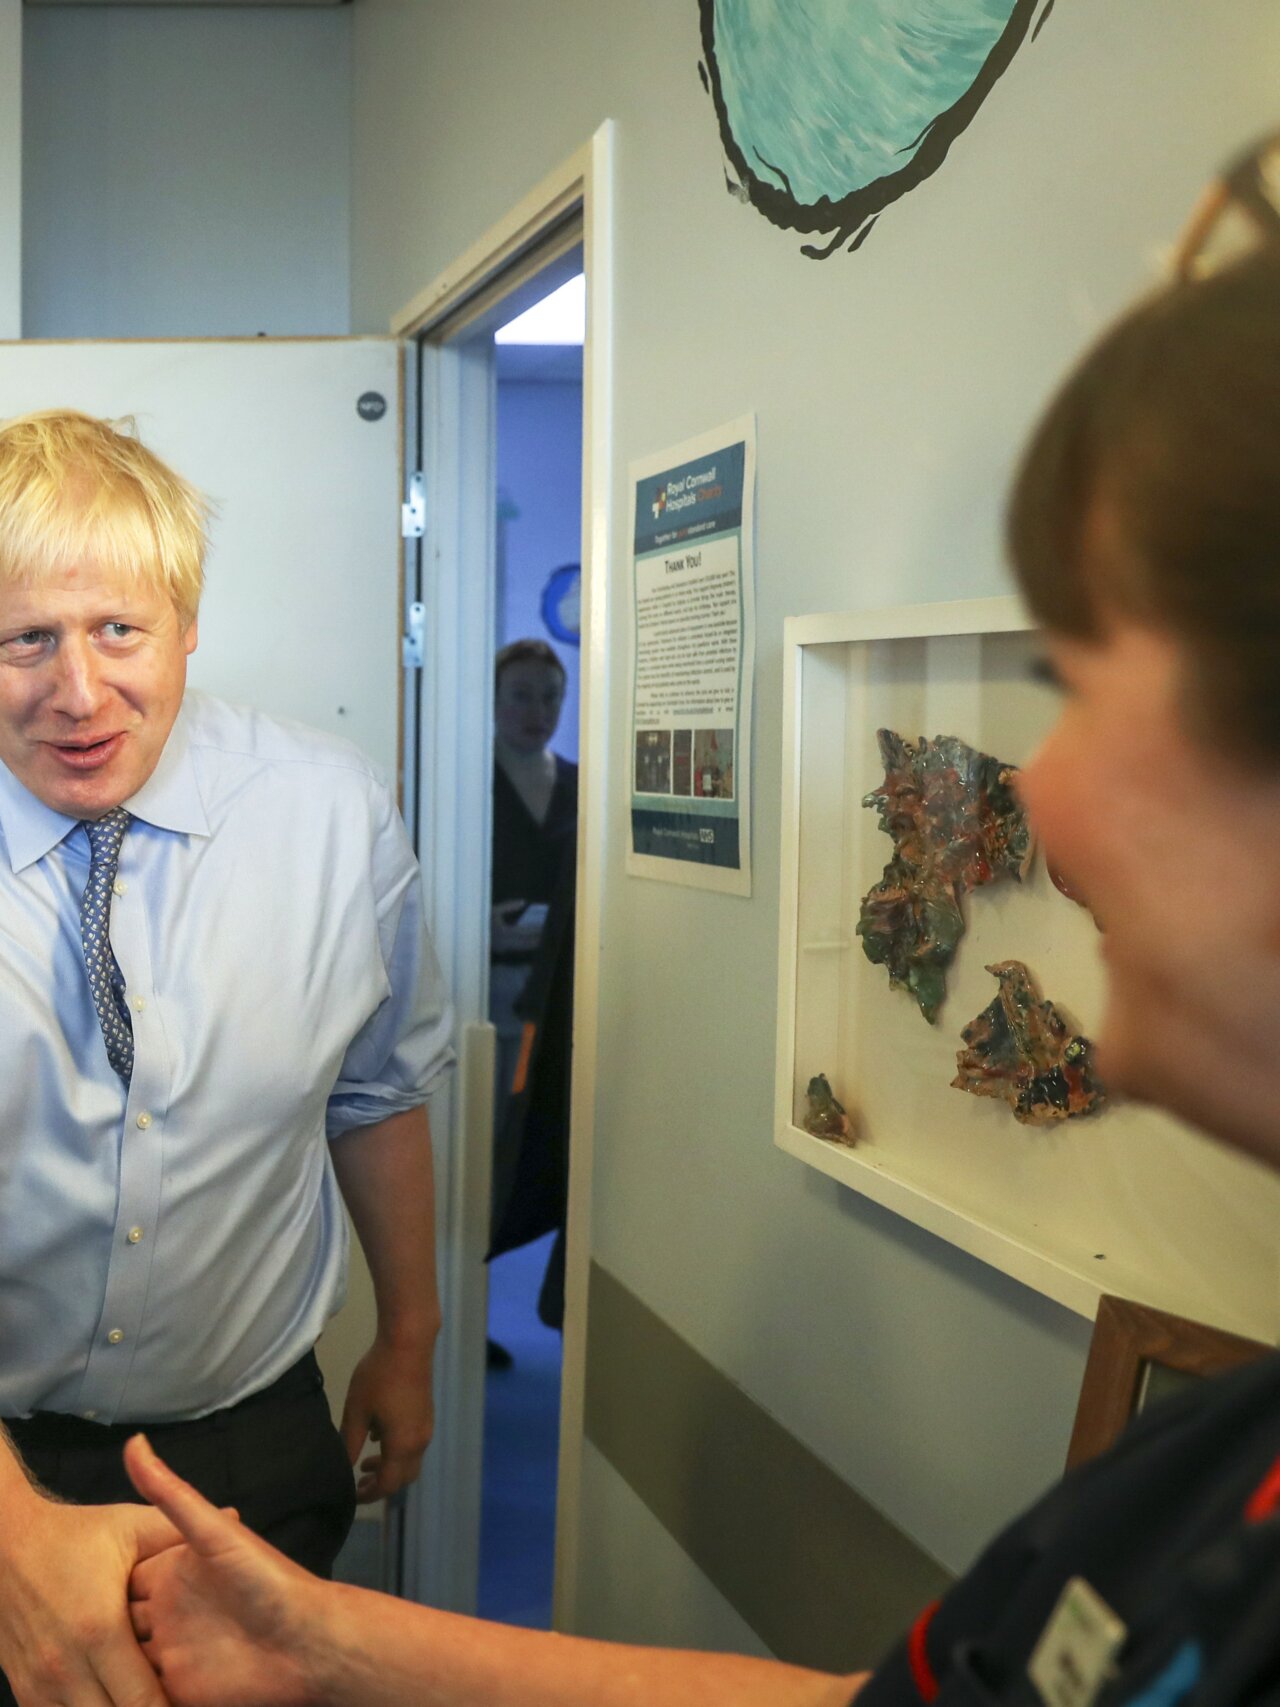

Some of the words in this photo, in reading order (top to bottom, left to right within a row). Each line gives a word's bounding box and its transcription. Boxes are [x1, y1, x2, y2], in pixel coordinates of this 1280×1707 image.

[667, 479, 685, 496] Royal
[686, 467, 716, 489] Cornwall
[666, 492, 696, 511] Hospitals
[665, 560, 684, 573] THANK
[686, 552, 701, 568] YOU!
